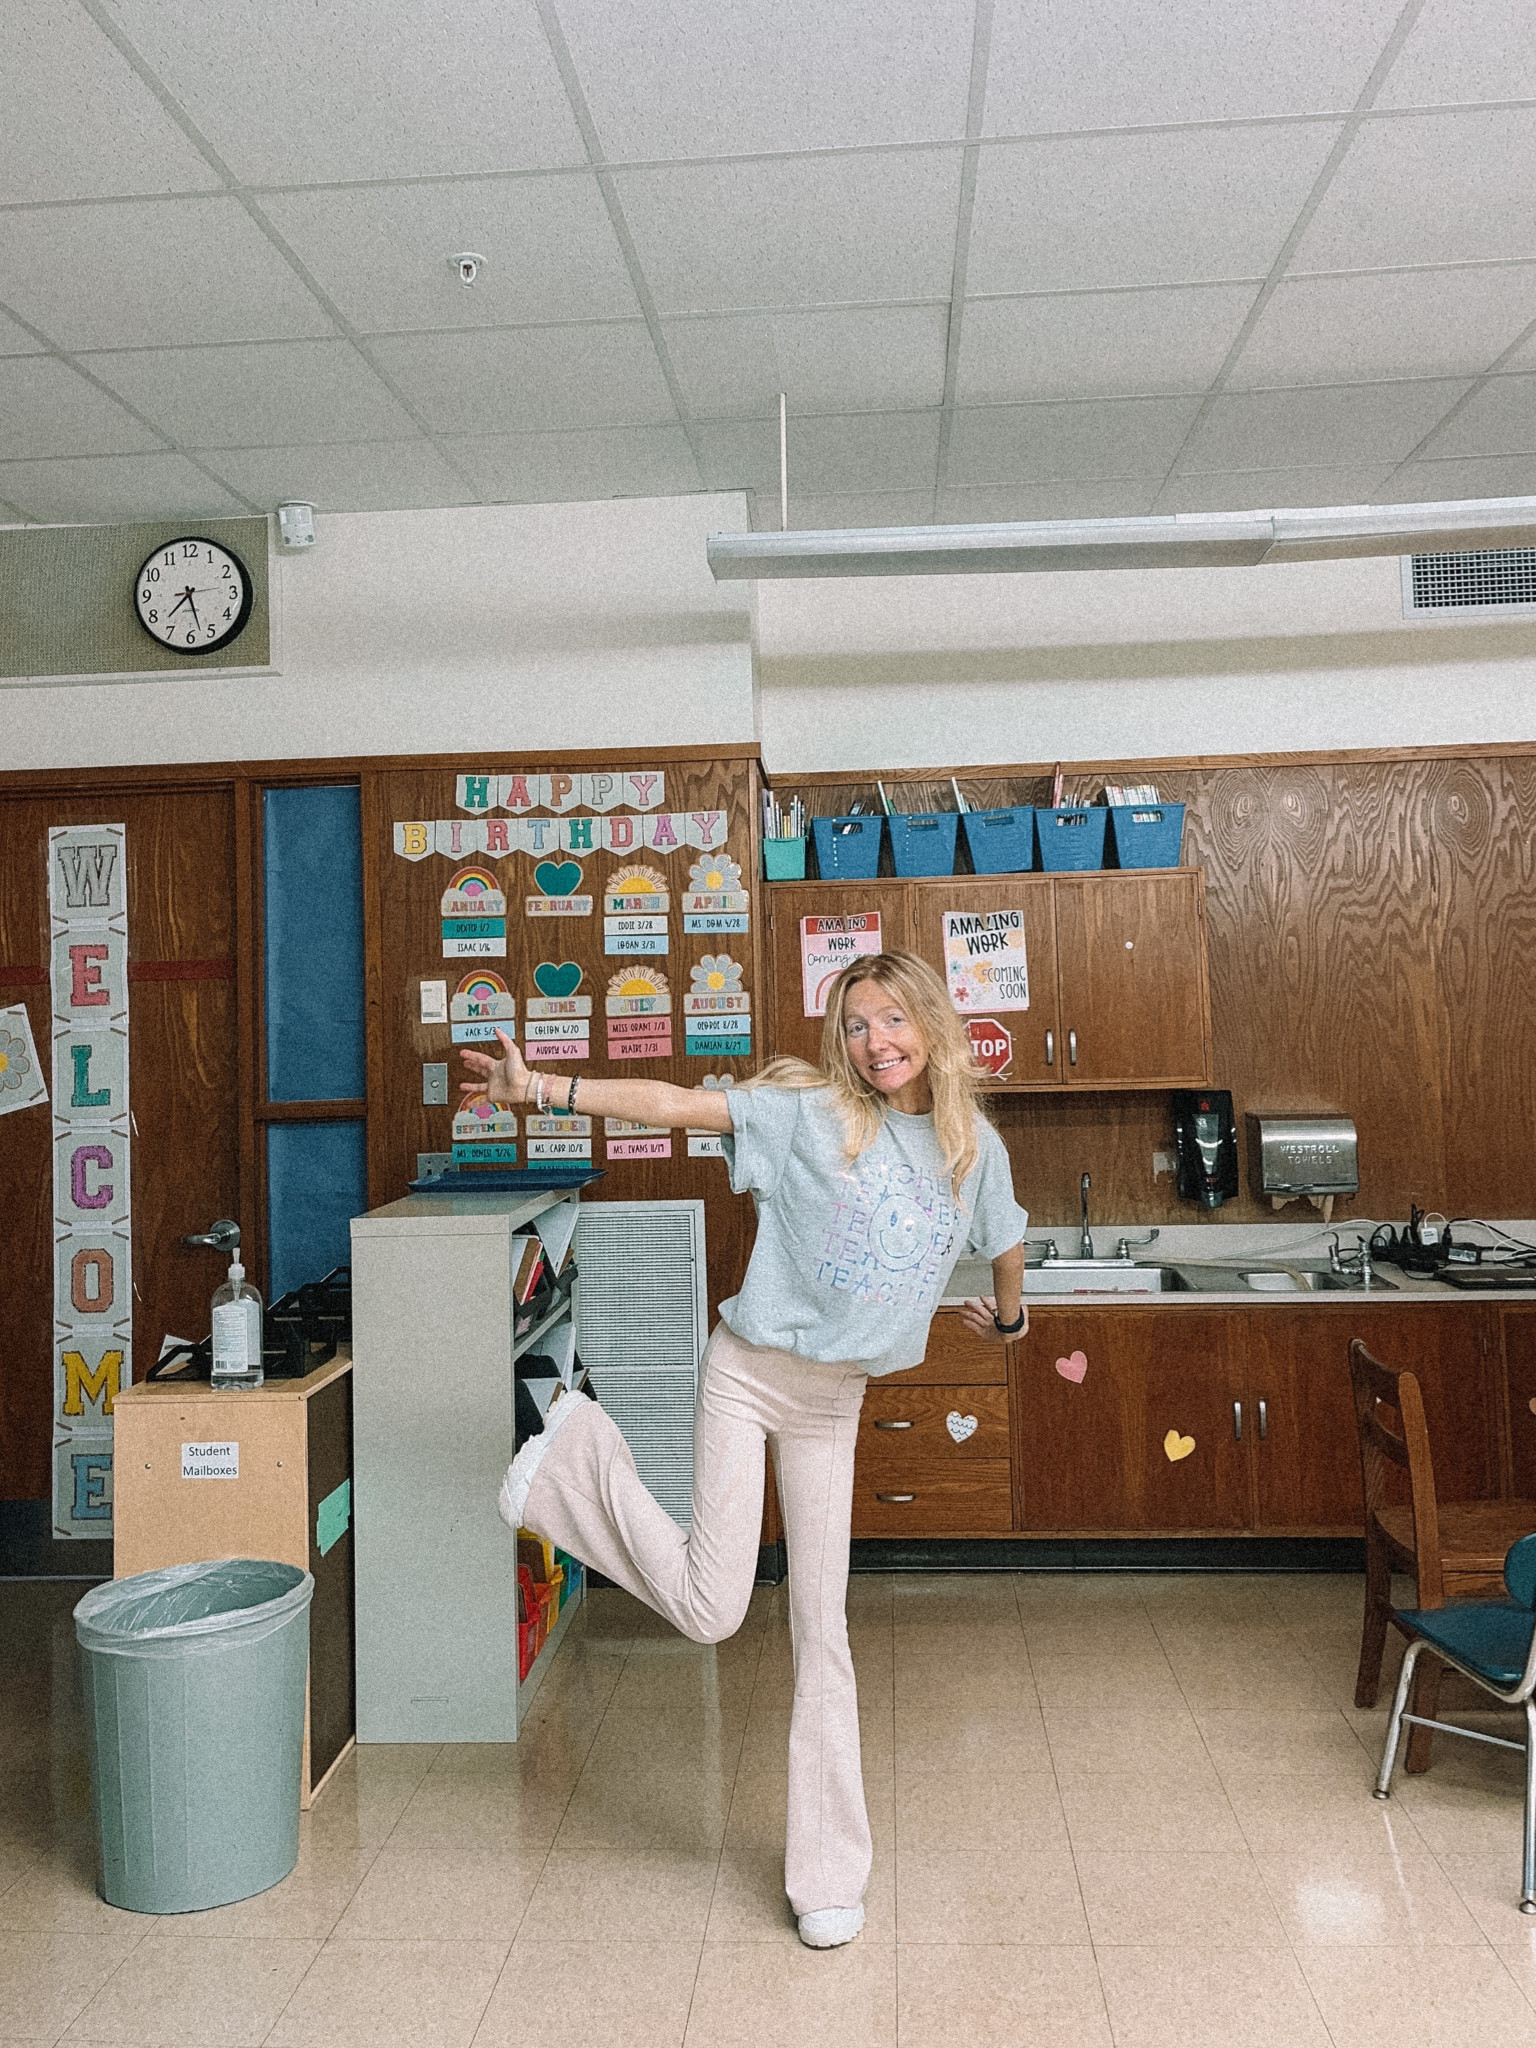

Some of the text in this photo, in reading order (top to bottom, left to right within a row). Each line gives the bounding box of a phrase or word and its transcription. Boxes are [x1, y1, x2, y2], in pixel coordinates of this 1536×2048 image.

[183, 544, 198, 558] 12
[207, 550, 213, 564] 1
[164, 552, 175, 565] 11
[146, 567, 160, 582] 10
[221, 564, 231, 579] 2
[142, 589, 152, 604] 9
[229, 585, 238, 599] 3
[148, 609, 158, 623] 8
[222, 606, 232, 620] 4
[165, 625, 175, 640] 7
[186, 629, 195, 644] 6
[207, 624, 216, 638] 5
[464, 774, 658, 808] HAPPY
[403, 812, 720, 854] BIRTHDAY
[445, 900, 503, 912] JANUARY
[528, 900, 590, 912] FEBRUARY
[612, 896, 660, 910] MARCH
[693, 896, 736, 909] APRIL
[456, 923, 477, 933] DEXTER
[618, 921, 653, 931] EDDIE 3/28
[724, 918, 741, 928] 4/28
[457, 943, 476, 952] ISAAC
[617, 940, 656, 950] LOGAN 3/31
[828, 937, 856, 950] WORK
[966, 932, 1009, 955] WORK
[808, 953, 851, 968] Coming
[1000, 983, 1027, 999] SOON
[467, 1002, 499, 1016] MAY
[541, 1001, 576, 1014] JUNE
[619, 997, 657, 1012] JULY
[691, 996, 743, 1010] AUGUST
[534, 1024, 579, 1035] COLTON 6/20
[612, 1023, 628, 1032] MISS
[722, 1020, 738, 1029] 8/28
[464, 1026, 501, 1037] JACK 5/3
[643, 1042, 659, 1052] 7/31
[695, 1041, 723, 1051] DAMIAN
[970, 1038, 1007, 1057] TOP
[456, 1122, 515, 1134] SEPTEMBER
[531, 1119, 587, 1132] OCTOBER
[535, 1143, 584, 1153] MS. CARR 10/8
[613, 1145, 626, 1154] MS.
[628, 1144, 649, 1154] EVANS
[1280, 1144, 1340, 1154] WESTROLL
[1287, 1155, 1332, 1165] TOWELS
[57, 844, 124, 1521] WELCOME
[188, 1446, 231, 1456] Student
[182, 1464, 238, 1476] Mailboxes
